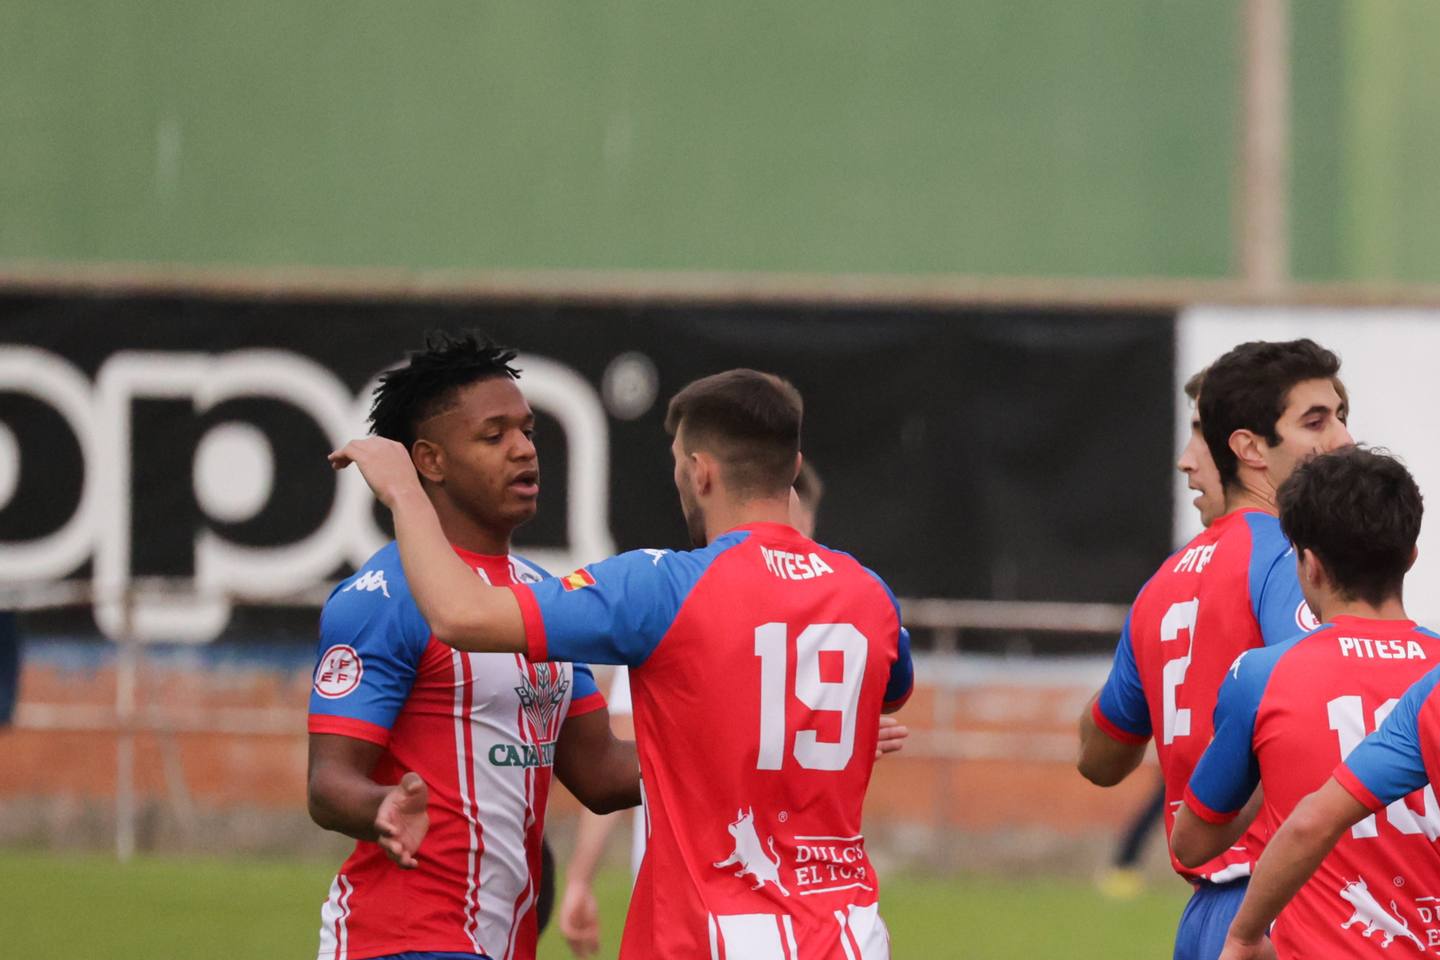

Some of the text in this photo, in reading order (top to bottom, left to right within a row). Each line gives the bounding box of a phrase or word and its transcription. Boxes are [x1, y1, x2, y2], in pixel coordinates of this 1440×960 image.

[1338, 637, 1426, 660] PITESA
[754, 622, 868, 770] 19
[795, 865, 823, 886] EL
